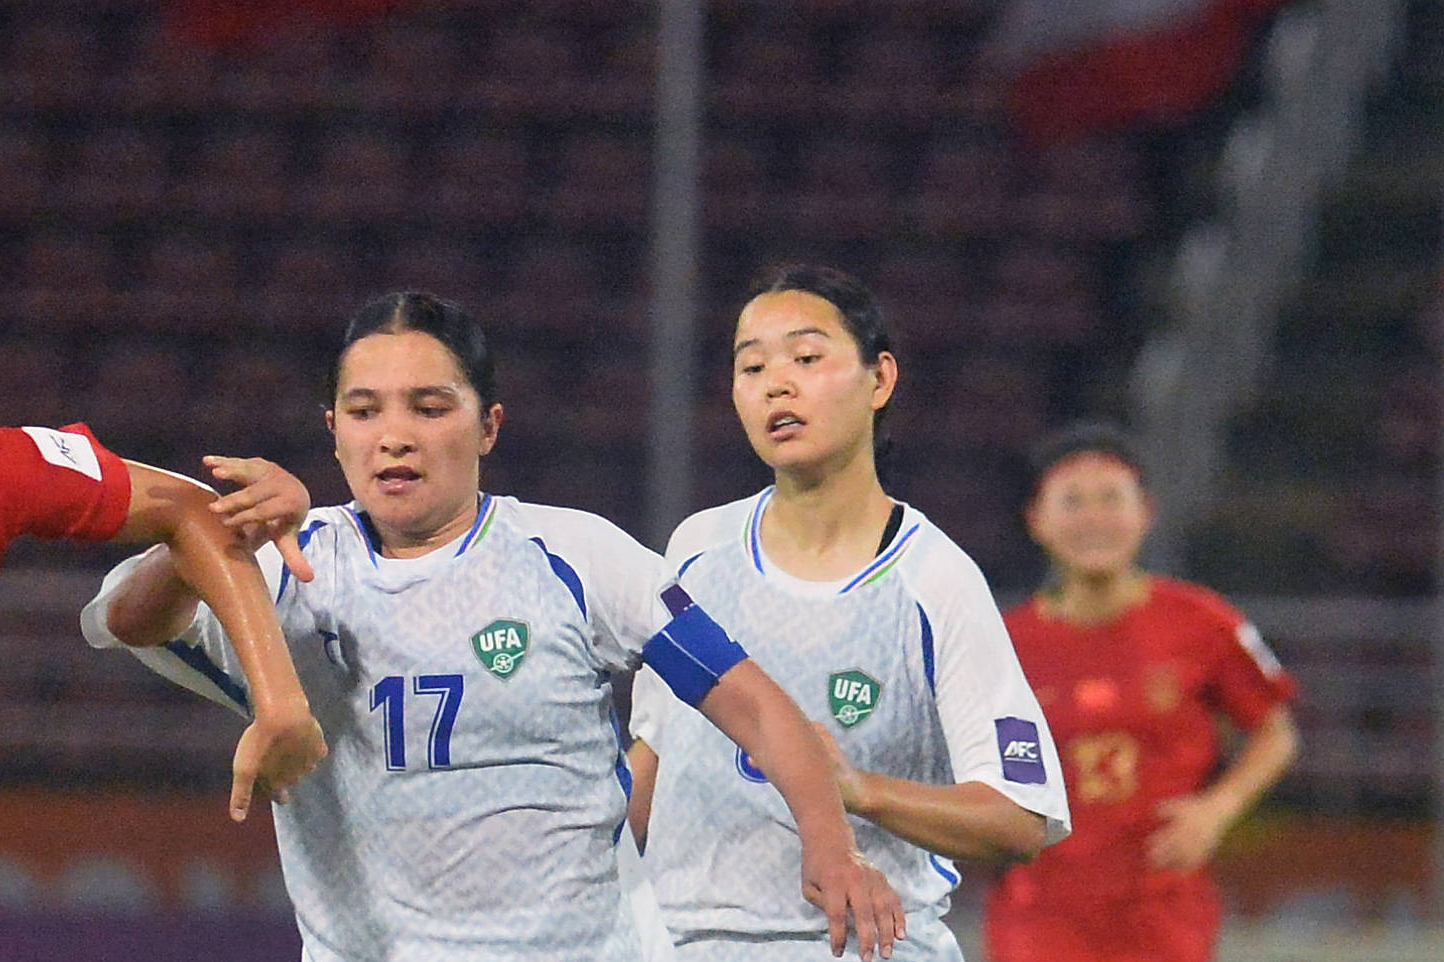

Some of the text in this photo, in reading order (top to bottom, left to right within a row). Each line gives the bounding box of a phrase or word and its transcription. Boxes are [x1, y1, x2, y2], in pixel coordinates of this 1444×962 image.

[479, 628, 522, 652] UFA
[833, 678, 872, 705] UFA
[369, 674, 464, 772] 17
[1003, 741, 1038, 759] AFC
